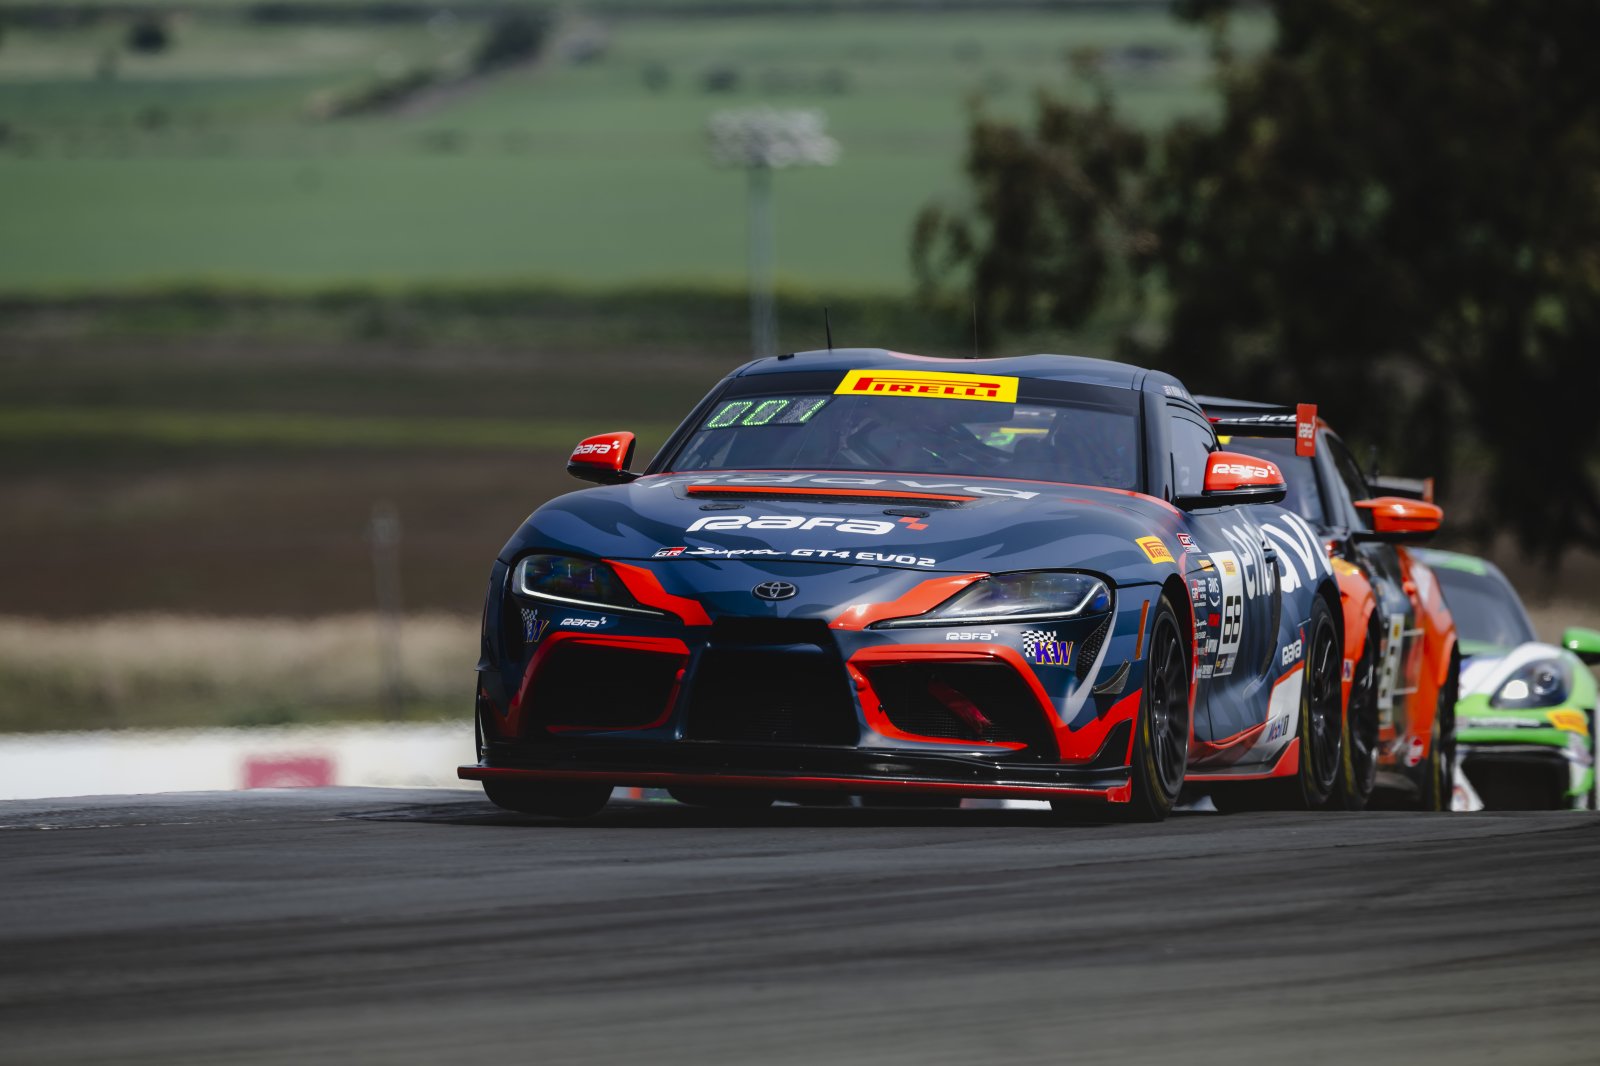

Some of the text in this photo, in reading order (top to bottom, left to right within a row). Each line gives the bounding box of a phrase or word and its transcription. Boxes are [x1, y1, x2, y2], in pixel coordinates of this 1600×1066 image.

[852, 377, 1001, 397] PIRELLI
[635, 473, 1041, 499] ndava
[655, 547, 936, 567] GR Supra GT4 EVO2
[1143, 541, 1172, 559] PIRE
[1222, 595, 1242, 645] 68
[1035, 641, 1074, 666] KW
